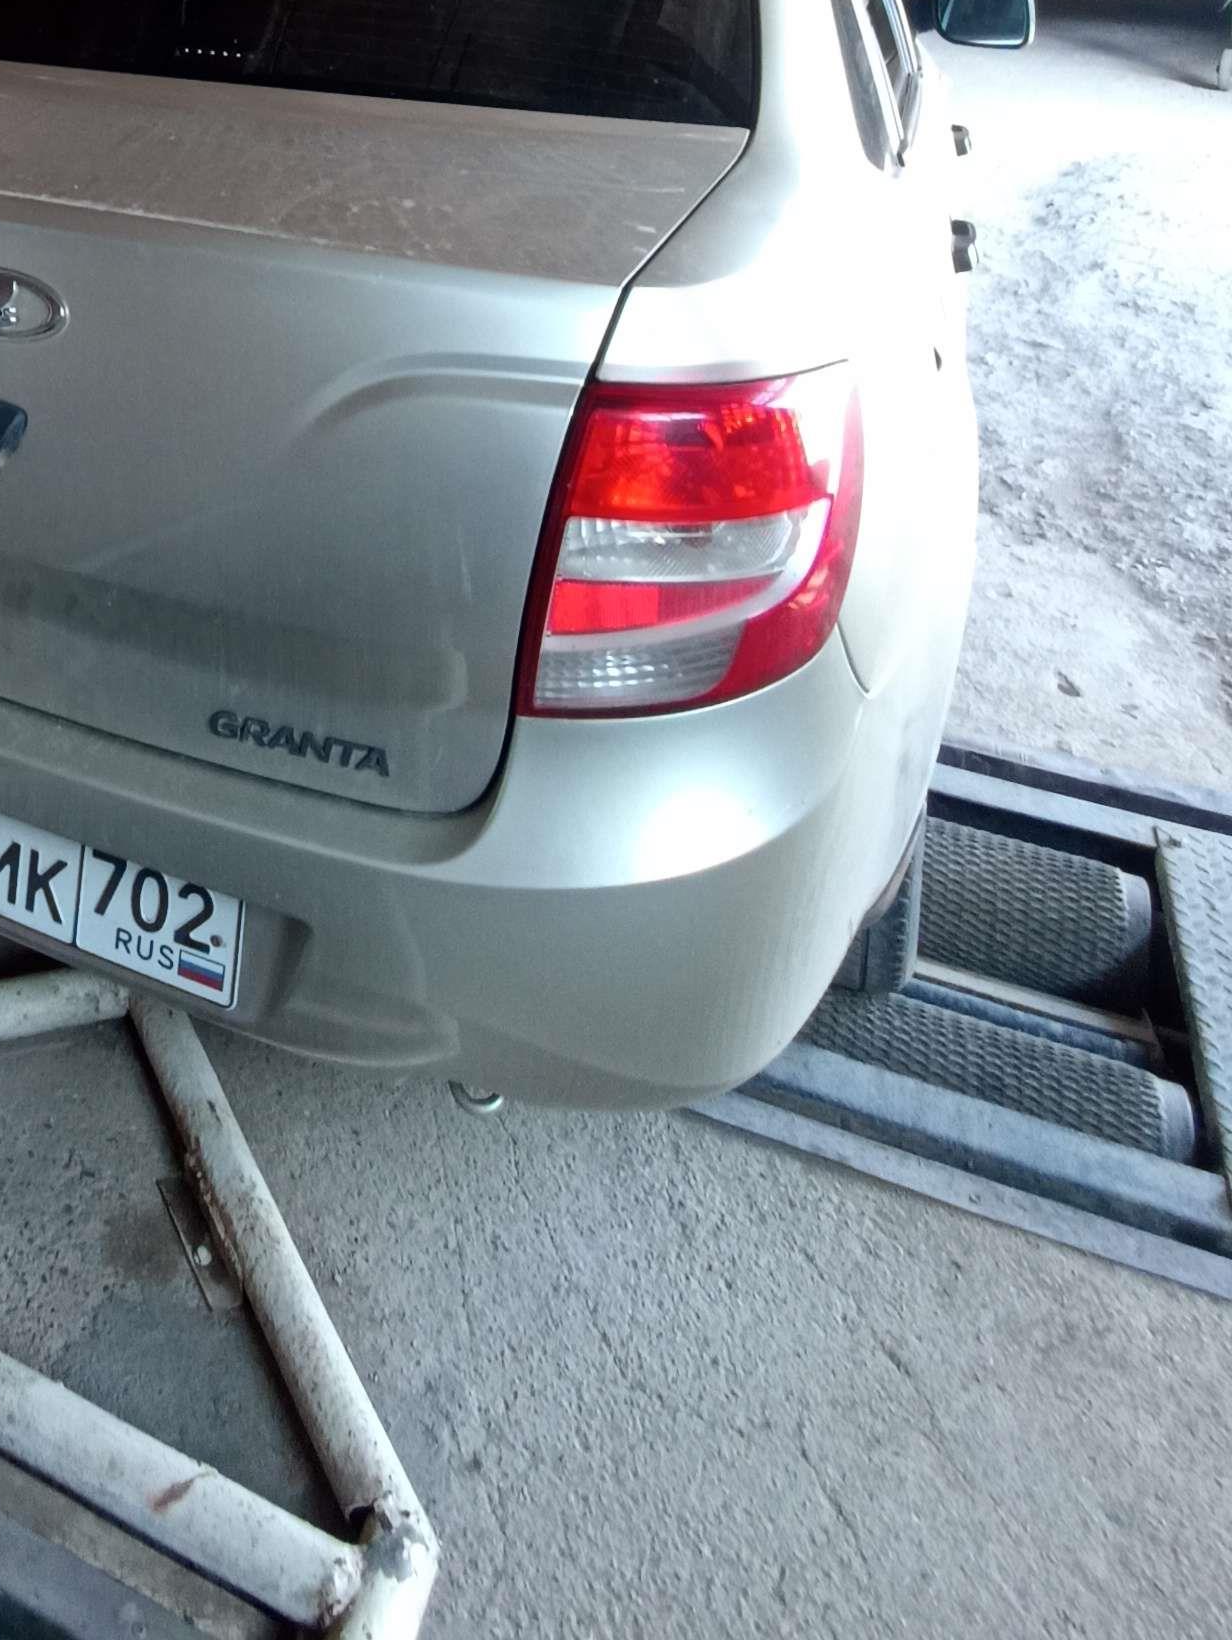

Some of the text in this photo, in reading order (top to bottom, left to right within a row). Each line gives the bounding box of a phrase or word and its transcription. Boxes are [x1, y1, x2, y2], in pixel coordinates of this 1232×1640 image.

[208, 709, 390, 778] GRANTA
[91, 848, 215, 955] 702
[114, 927, 175, 970] RUS
